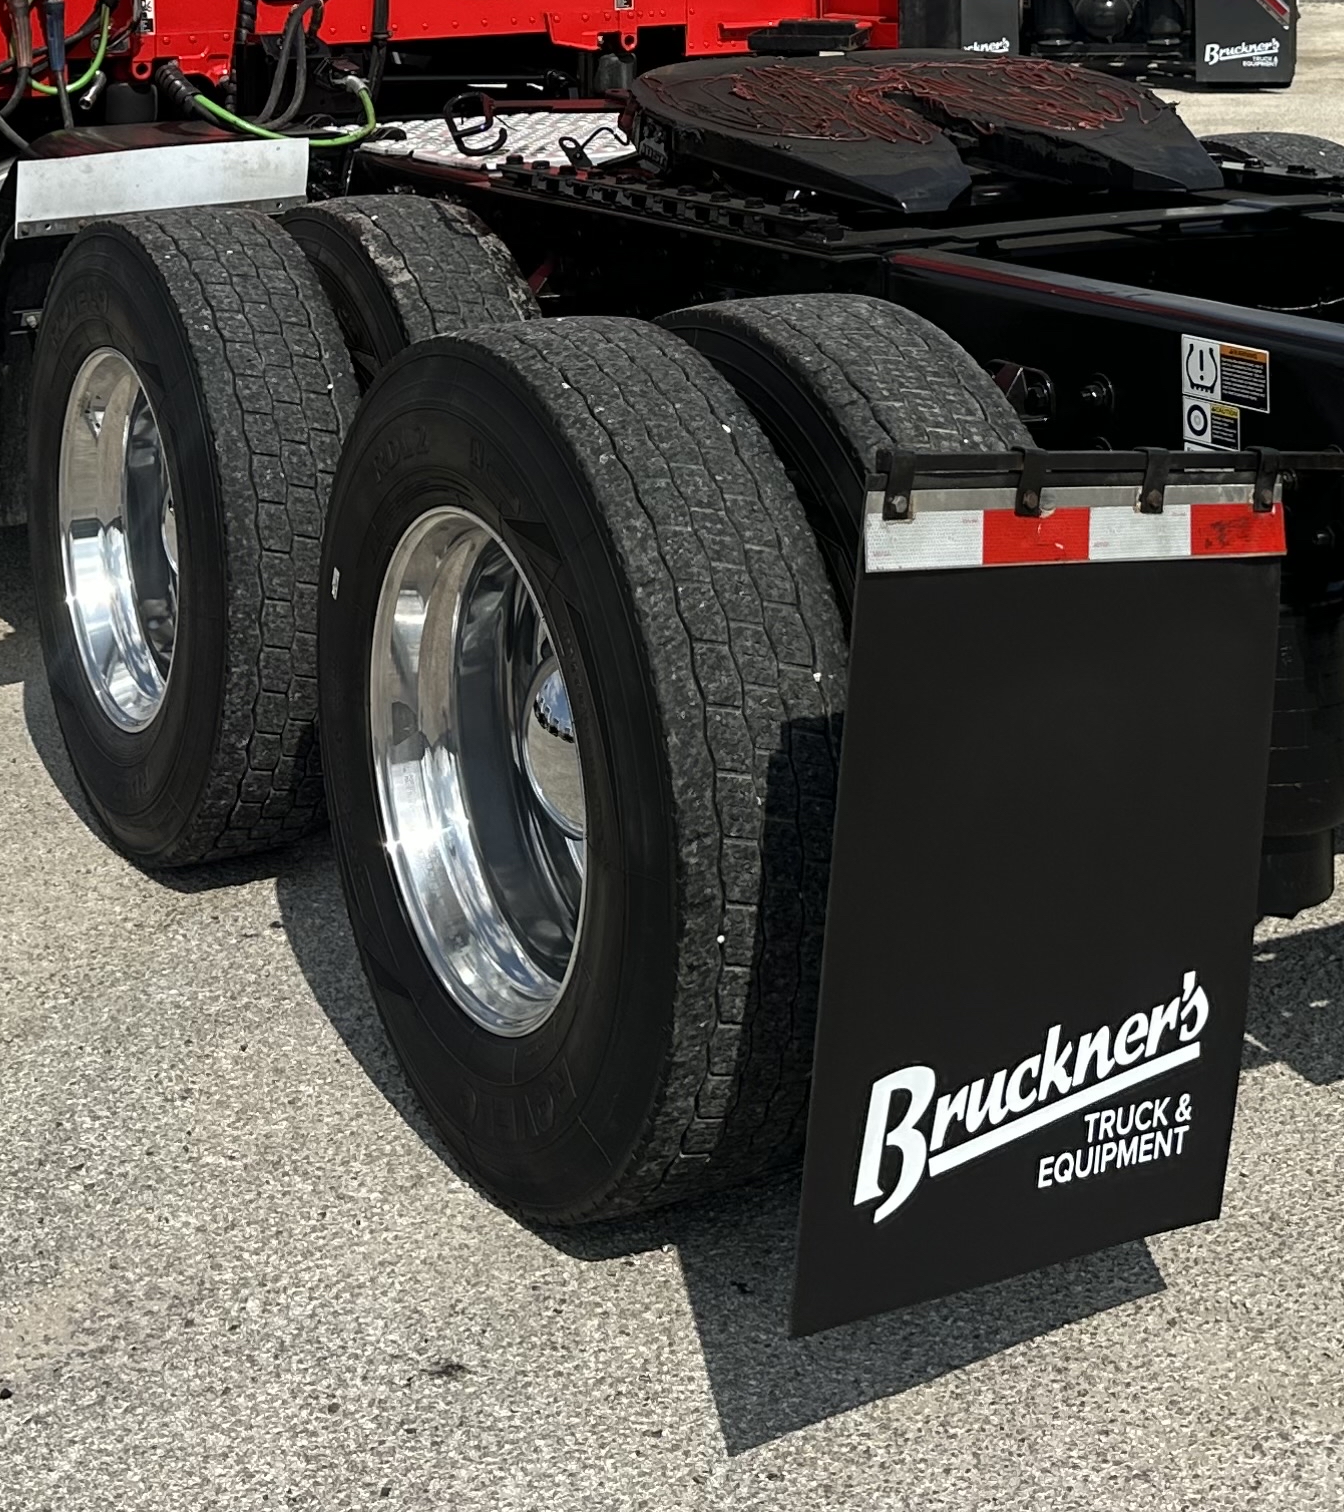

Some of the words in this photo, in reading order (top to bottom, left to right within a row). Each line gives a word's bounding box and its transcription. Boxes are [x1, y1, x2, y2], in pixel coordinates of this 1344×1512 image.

[1204, 37, 1280, 66] Bruckner's
[853, 970, 1210, 1224] Bruckner's
[1083, 1096, 1172, 1143] TRUCK
[1174, 1093, 1193, 1123] &
[1036, 1124, 1191, 1189] EQUIPMENT
